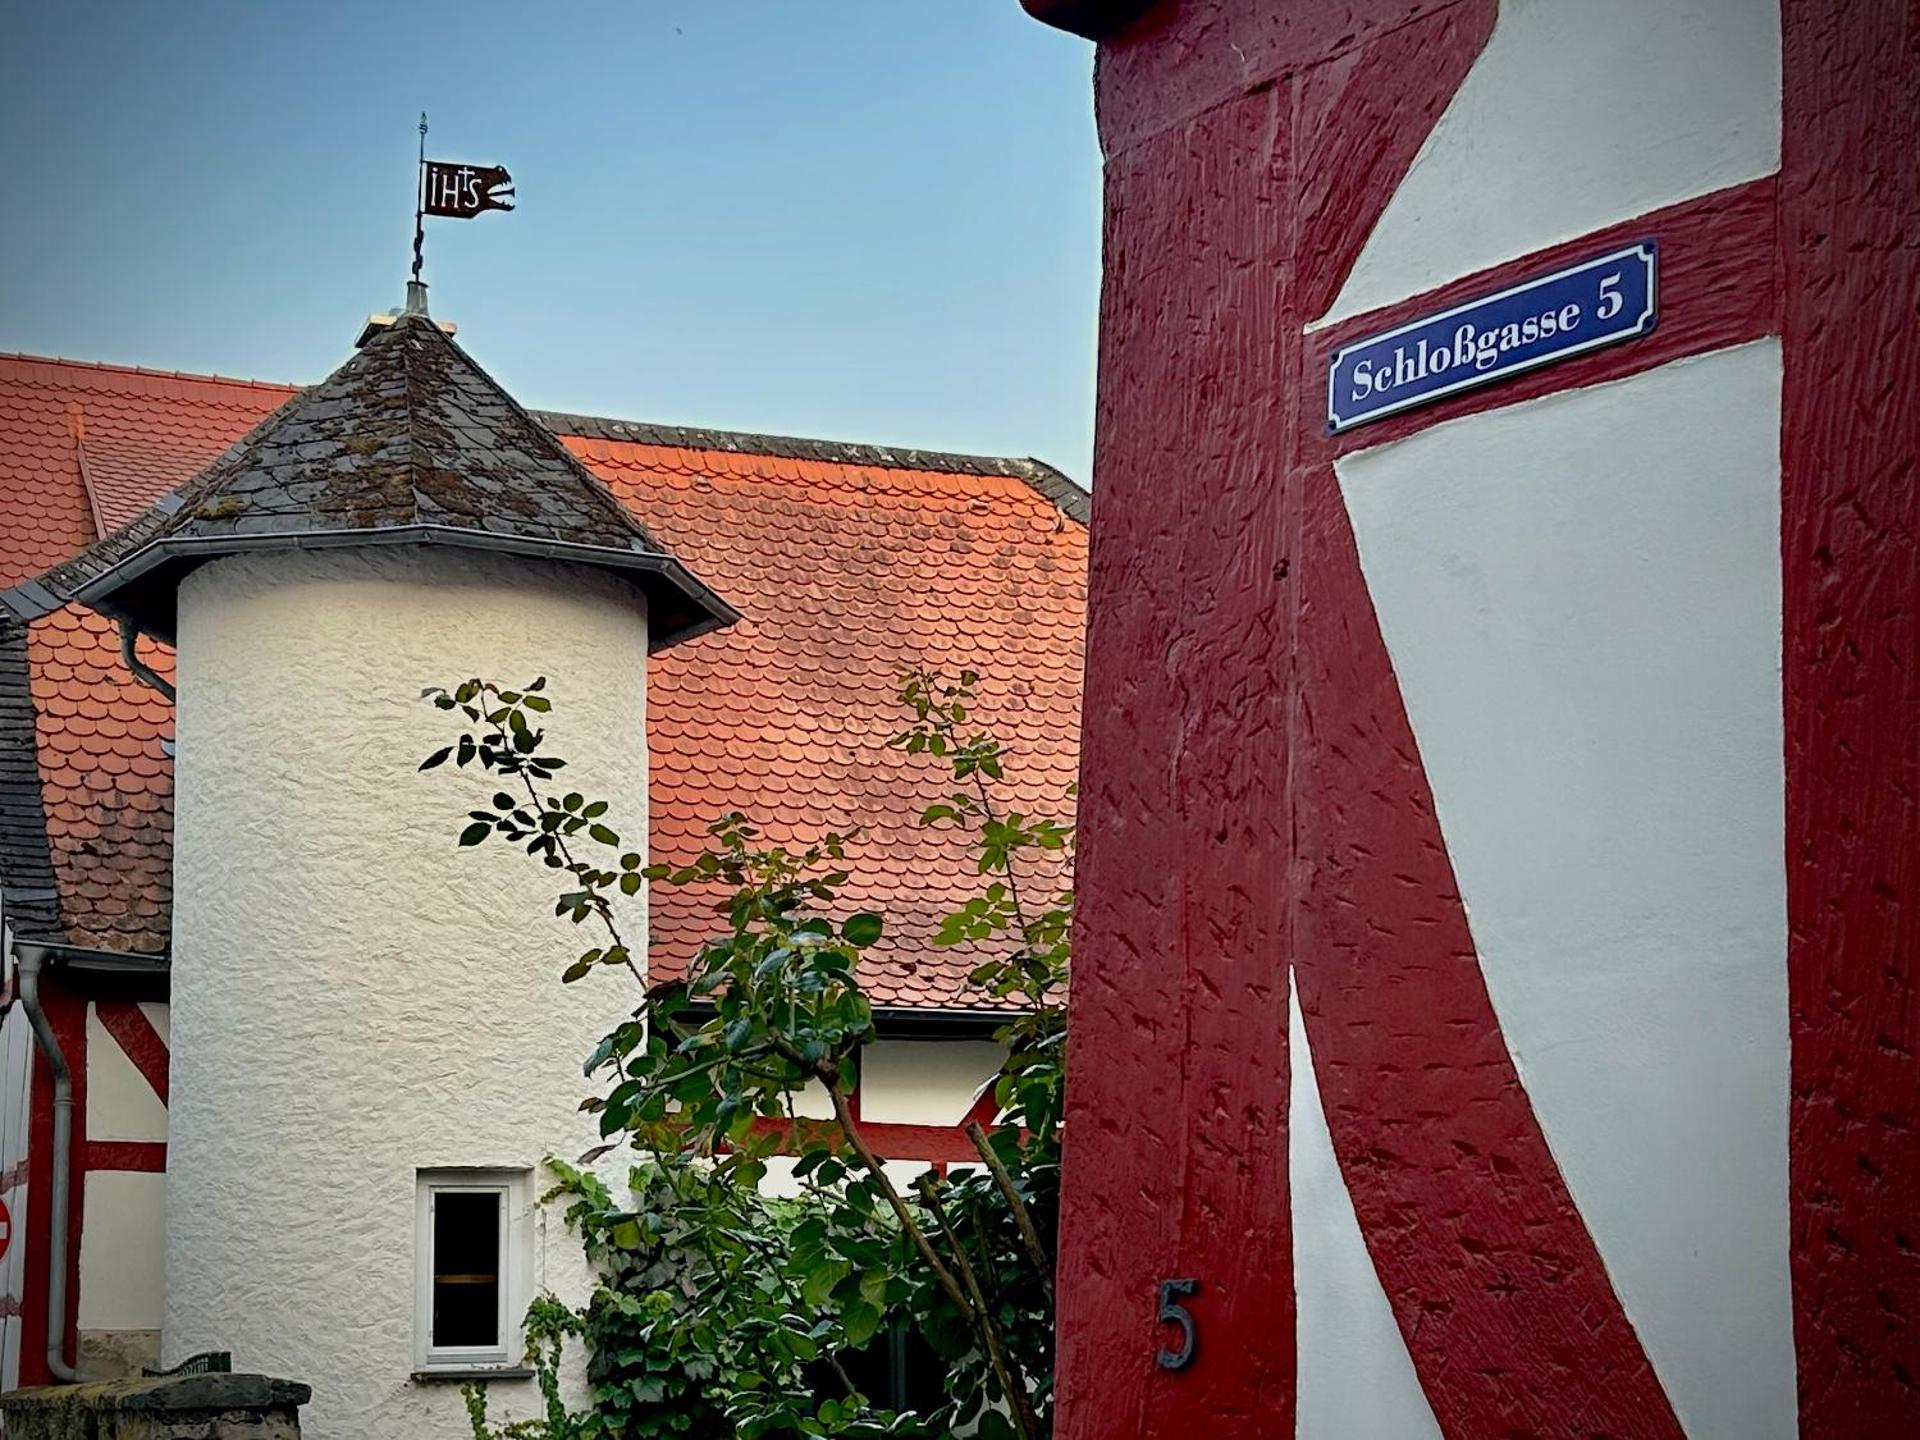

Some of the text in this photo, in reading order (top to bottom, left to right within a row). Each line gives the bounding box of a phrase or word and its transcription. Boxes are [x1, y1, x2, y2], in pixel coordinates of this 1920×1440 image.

[1351, 272, 1624, 402] Schloßgasse 5
[1157, 1278, 1196, 1370] 5
